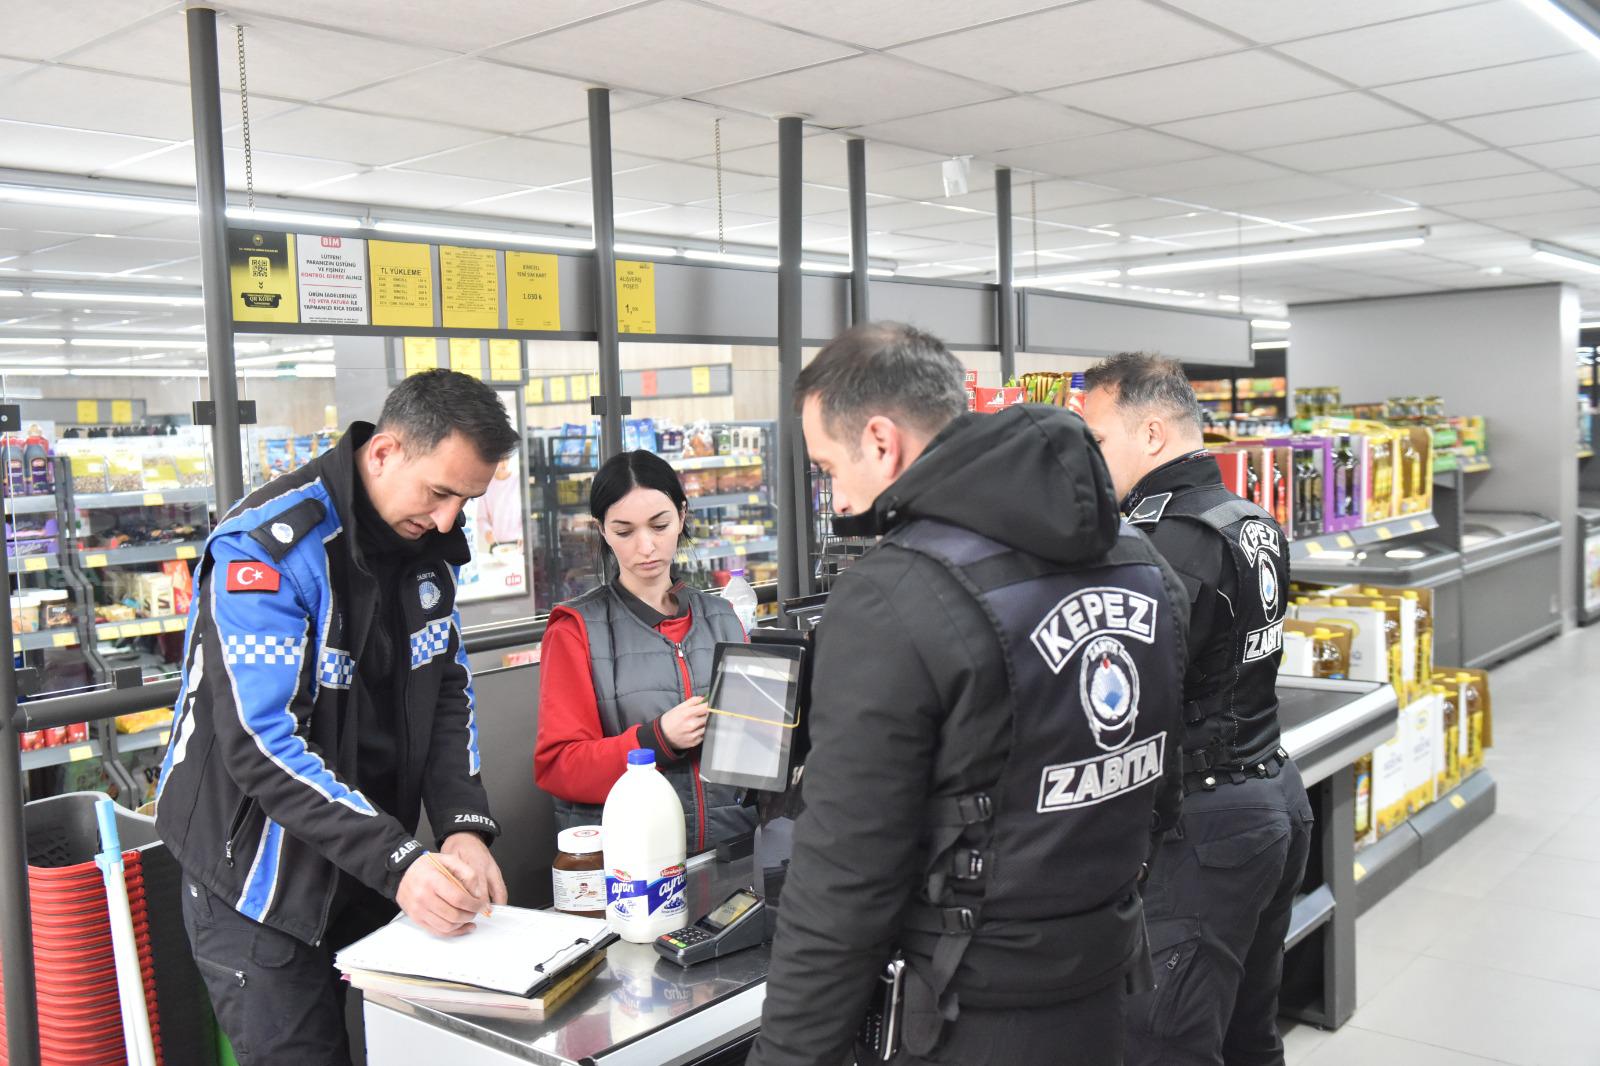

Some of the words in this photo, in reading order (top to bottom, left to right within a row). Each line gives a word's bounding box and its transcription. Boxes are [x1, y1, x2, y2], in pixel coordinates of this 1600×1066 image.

[381, 267, 389, 275] TL
[390, 266, 422, 276] YÜKLEME
[1242, 522, 1278, 562] KEPEZ
[1041, 592, 1151, 663] KEPEZ
[1246, 621, 1283, 659] ZABIT
[1044, 741, 1160, 807] ZABITA
[454, 814, 496, 829] ZABITA
[611, 882, 634, 902] ayran
